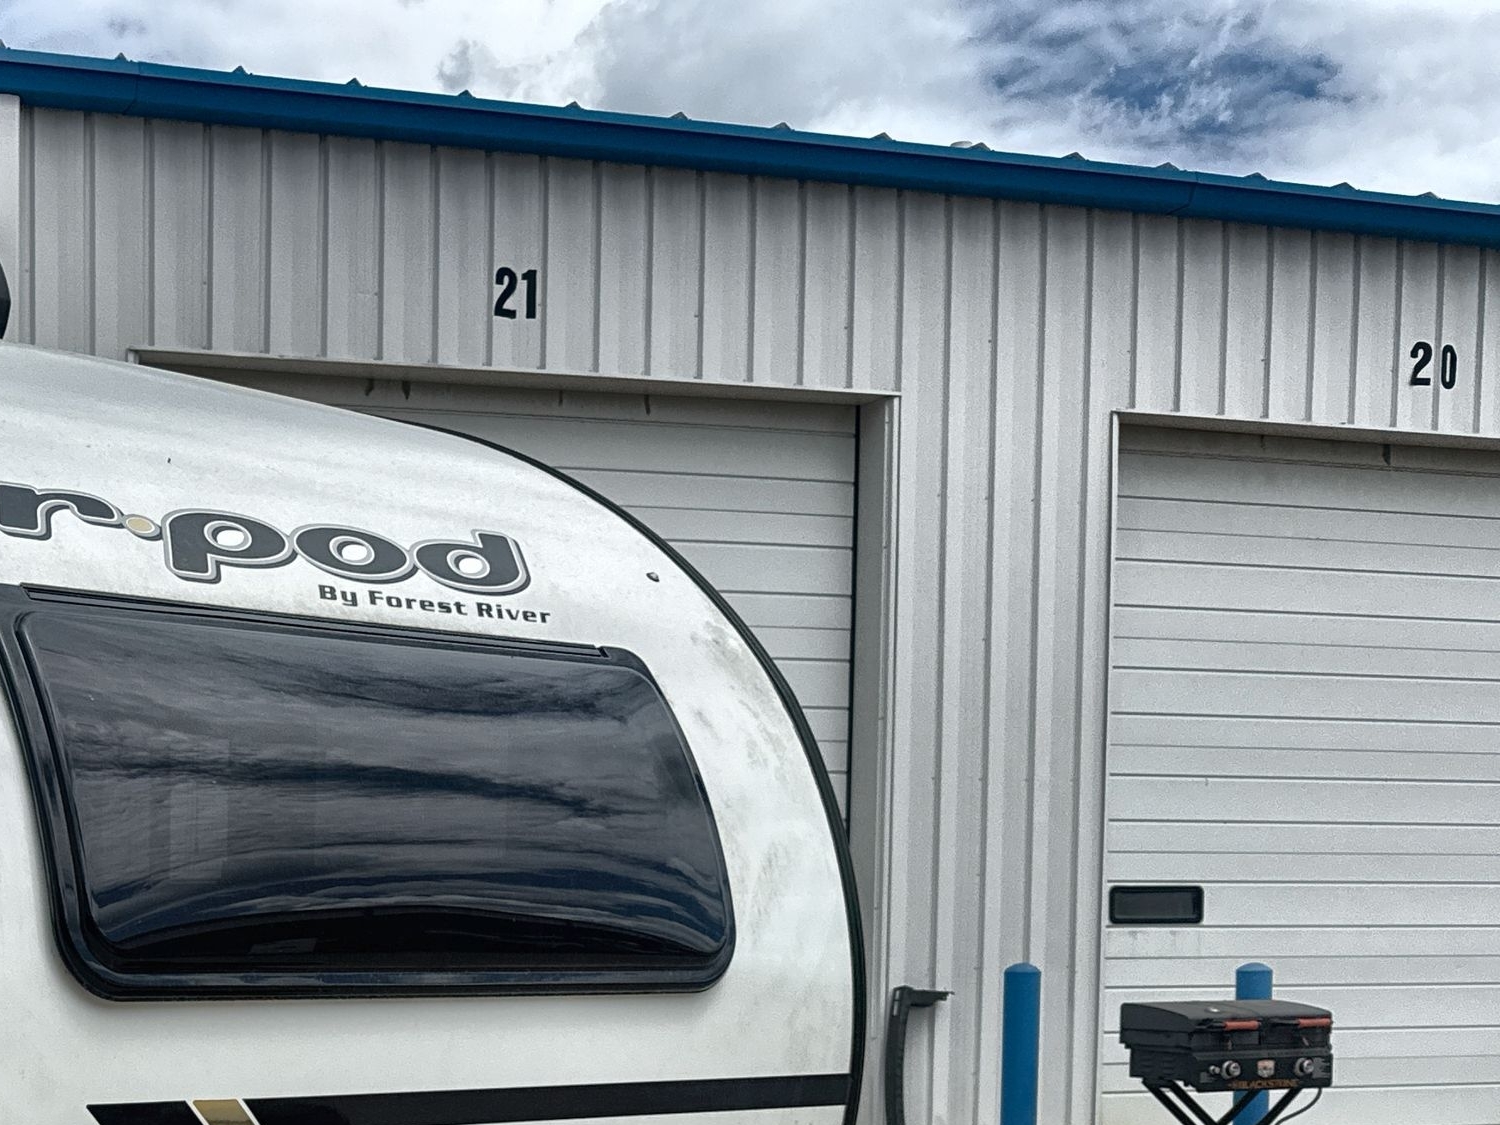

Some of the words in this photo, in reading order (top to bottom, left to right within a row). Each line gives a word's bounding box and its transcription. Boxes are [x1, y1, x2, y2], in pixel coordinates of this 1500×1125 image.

[493, 266, 538, 320] 21
[1408, 341, 1458, 390] 20
[318, 584, 358, 607] By
[367, 590, 468, 616] Forest
[476, 602, 551, 624] River
